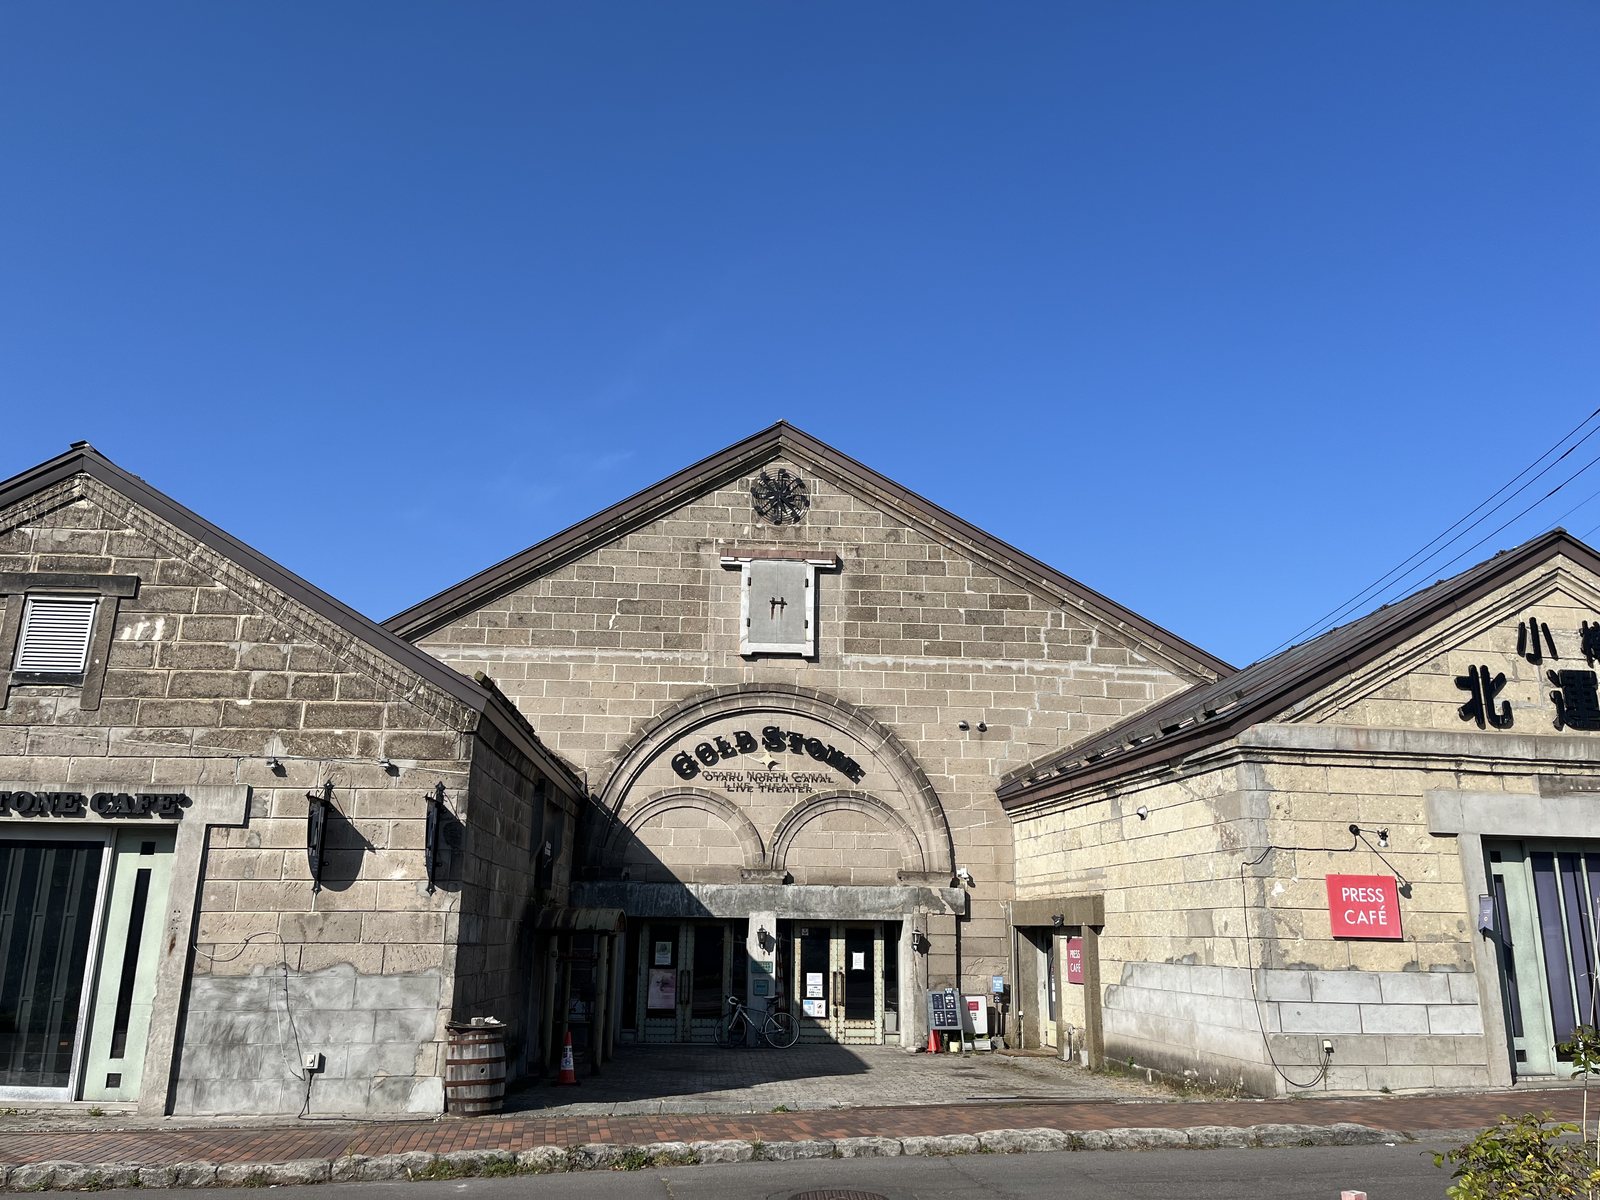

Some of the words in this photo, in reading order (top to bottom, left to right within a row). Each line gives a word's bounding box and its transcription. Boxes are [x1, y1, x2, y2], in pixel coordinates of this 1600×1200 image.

[671, 731, 758, 781] GOLD
[762, 726, 866, 785] STONE
[702, 771, 744, 782] OTARU
[747, 771, 788, 783] NORTH
[791, 772, 835, 784] CANAL
[724, 782, 753, 793] LIVE
[757, 783, 813, 794] THEATER
[1341, 887, 1385, 903] PRESS
[1344, 905, 1388, 925] CAFÉ
[1070, 949, 1081, 959] PRESS
